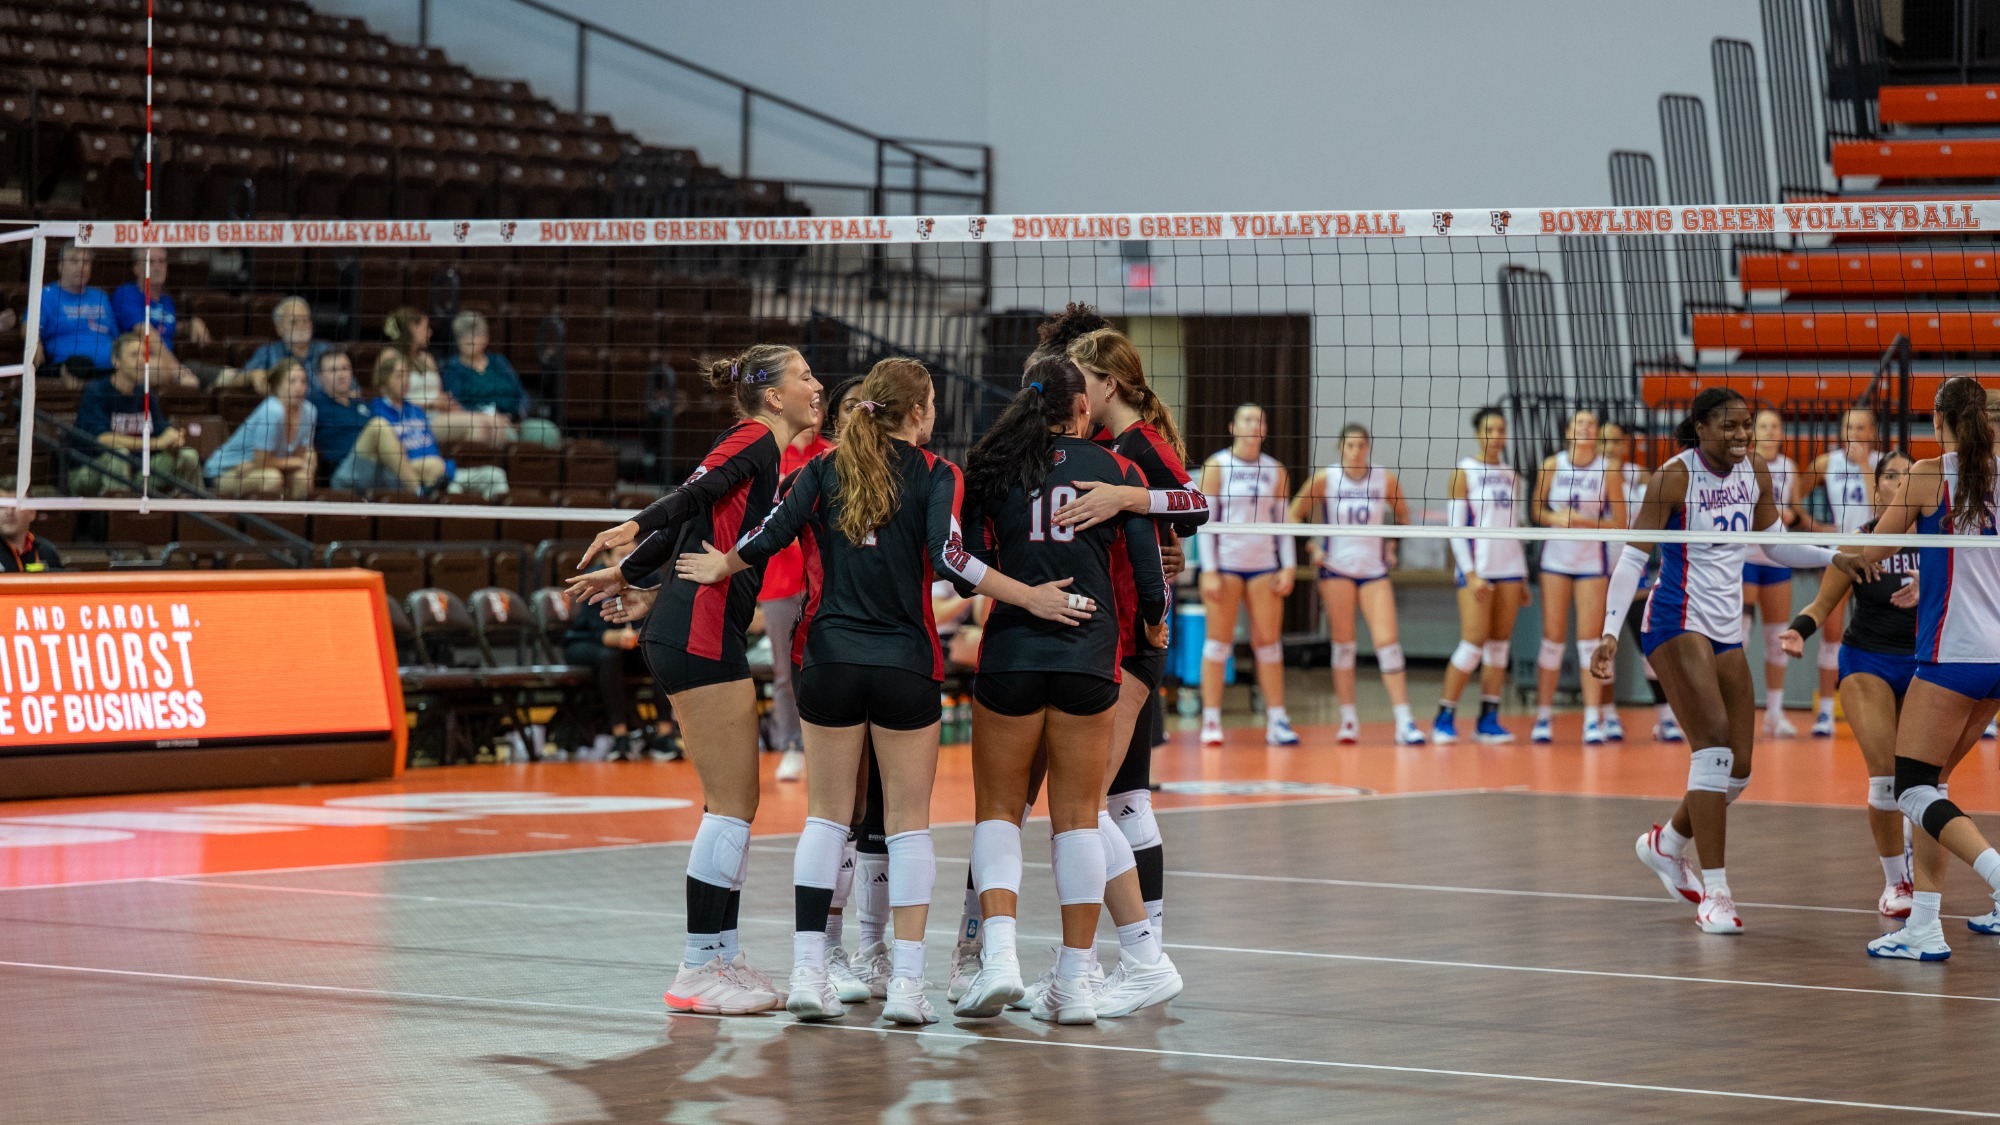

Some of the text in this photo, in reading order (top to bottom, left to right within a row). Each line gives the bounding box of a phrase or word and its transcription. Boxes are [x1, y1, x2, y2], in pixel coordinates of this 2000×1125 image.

[114, 221, 432, 243] BOWLING GREEN VOLLEYBALL
[540, 218, 892, 241] BOWLING GREEN VOLLEYBALL
[1012, 212, 1406, 239] BOWLING GREEN VOLLEYBALL
[1539, 204, 1980, 234] BOWLING GREEN VOLLEYBALL
[16, 603, 200, 631] AND CAROL M.
[21, 695, 58, 734] OF
[63, 689, 206, 733] BUSINESS
